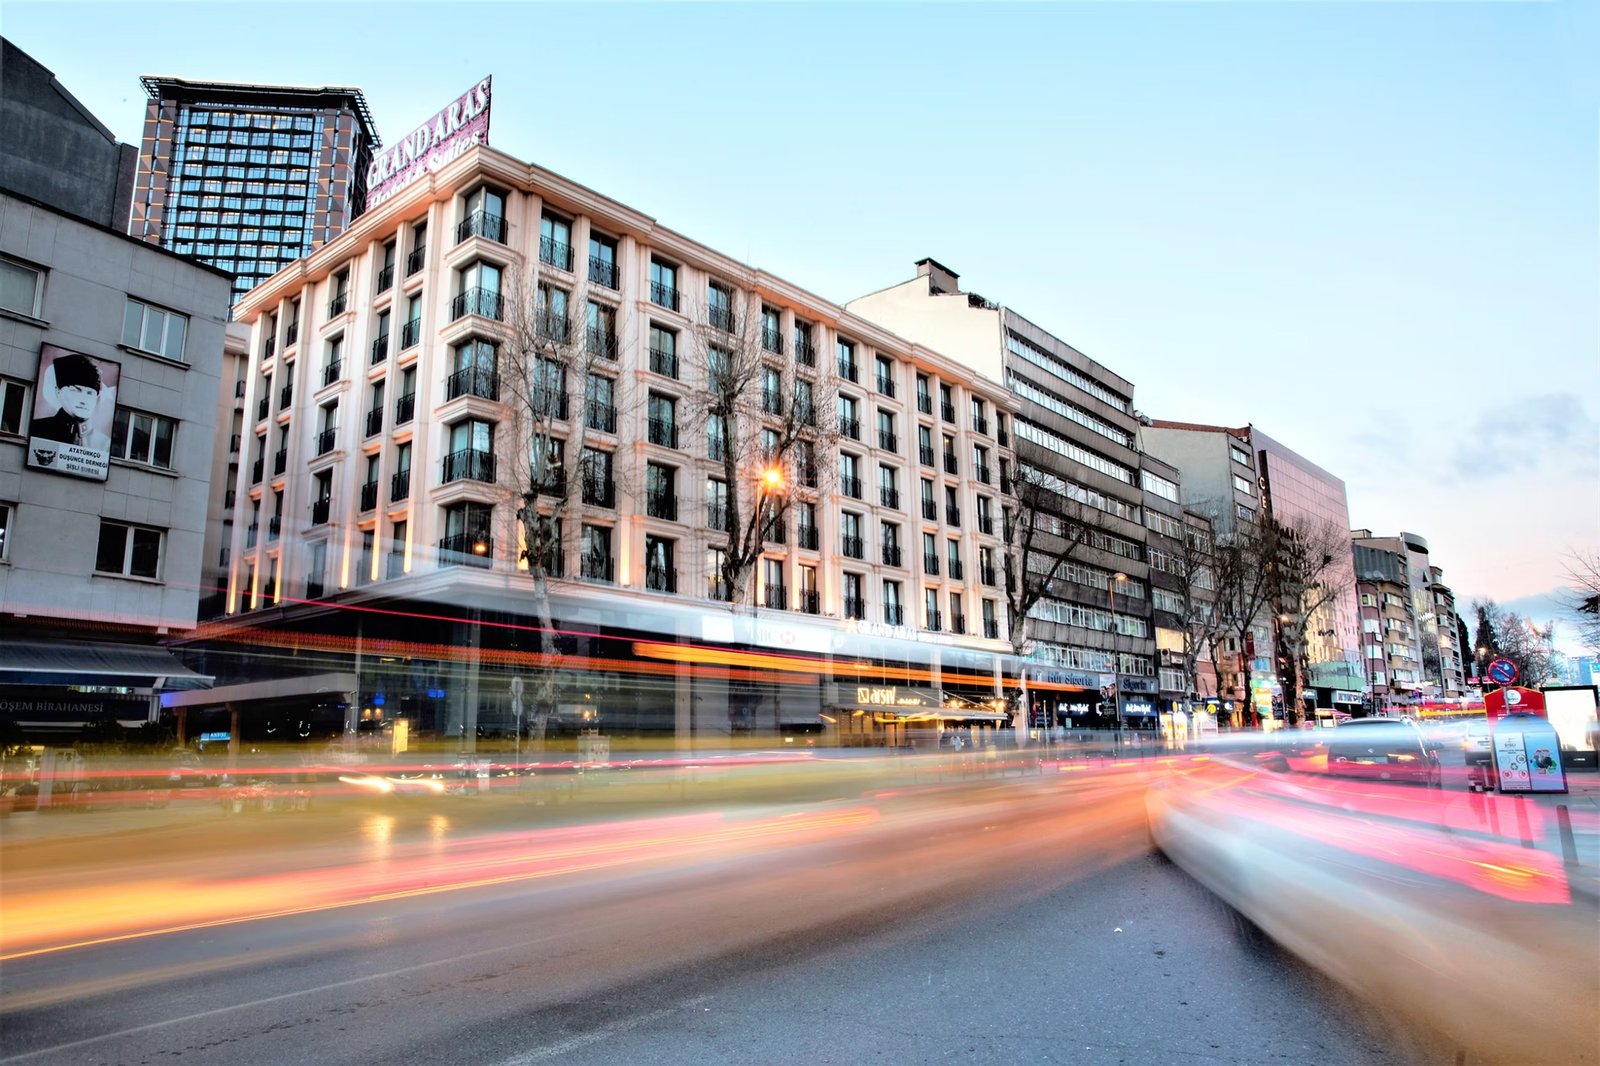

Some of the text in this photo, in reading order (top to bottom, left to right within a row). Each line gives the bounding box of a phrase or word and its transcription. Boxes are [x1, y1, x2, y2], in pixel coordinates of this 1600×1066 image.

[366, 79, 489, 191] GRAND ARAS
[69, 447, 101, 459] ATATÜRKÇÜ
